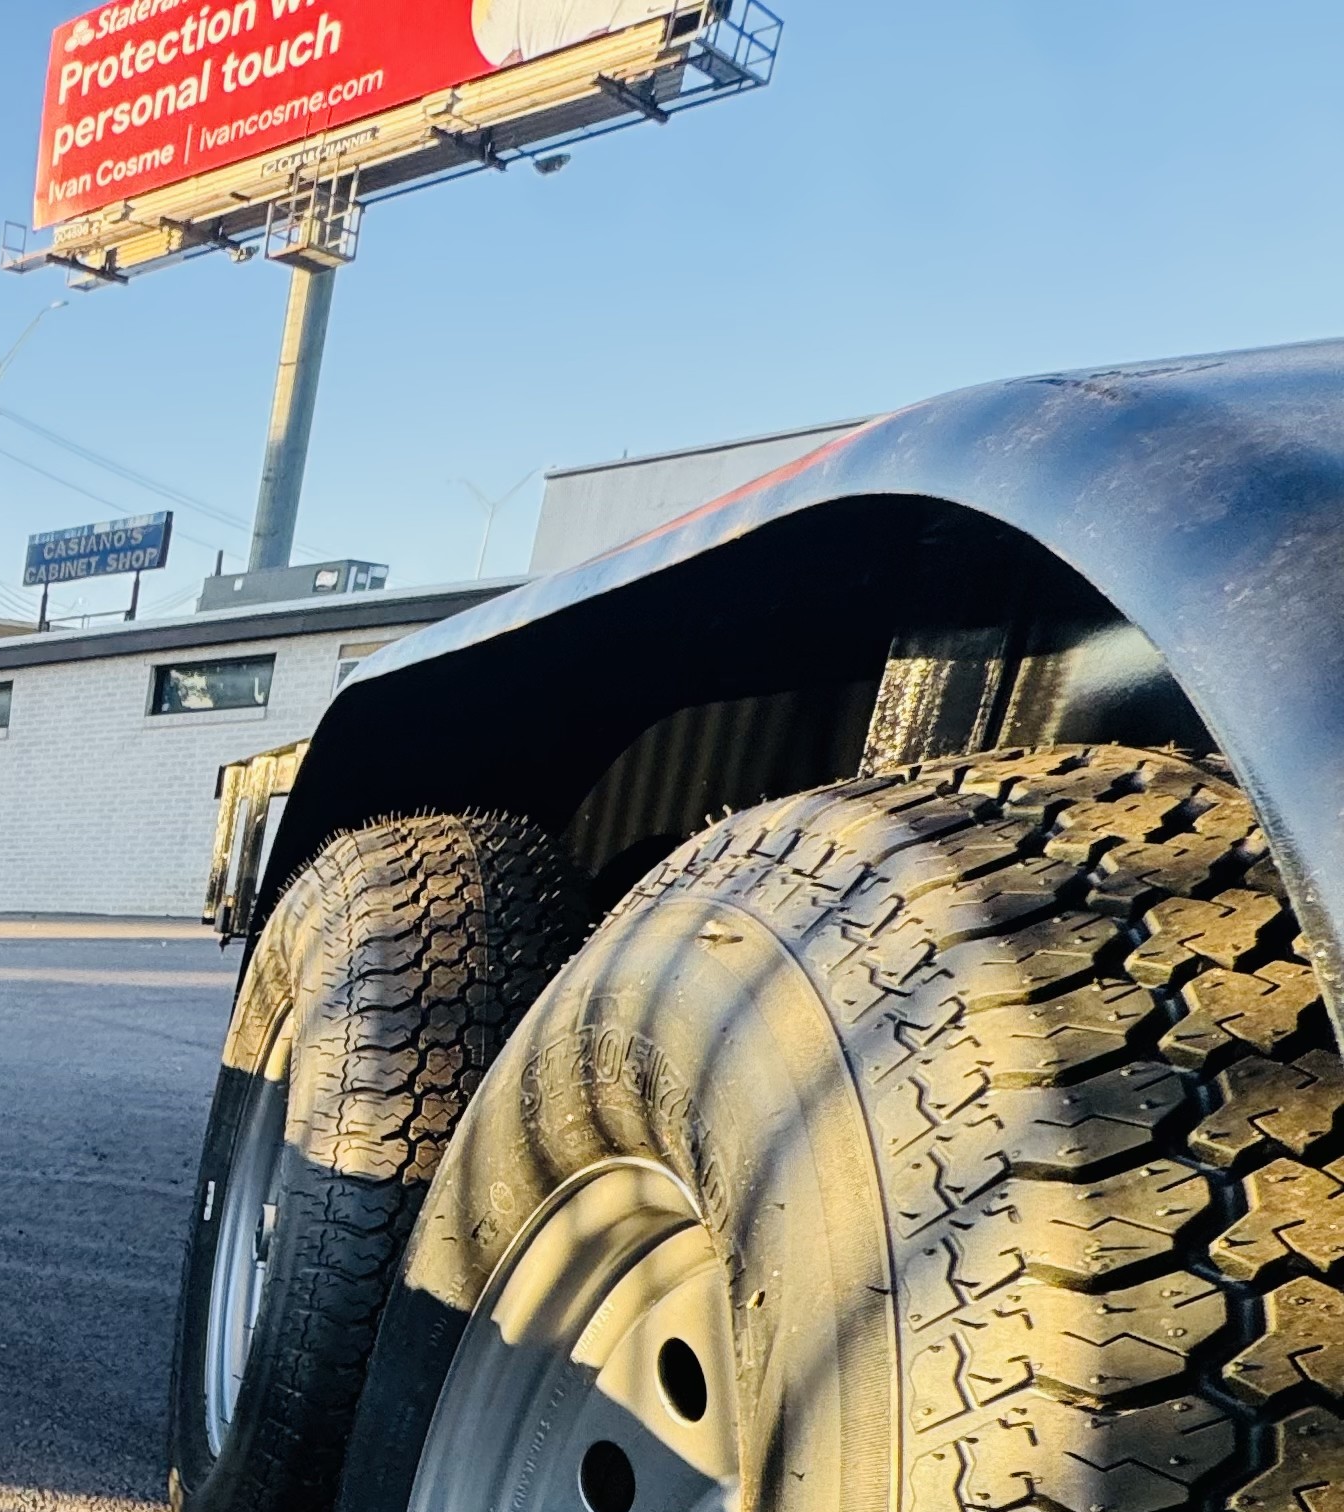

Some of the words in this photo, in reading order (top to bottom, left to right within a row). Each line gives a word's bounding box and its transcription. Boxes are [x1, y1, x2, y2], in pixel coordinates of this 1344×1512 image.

[58, 0, 256, 105] Protection
[52, 59, 212, 166] personal
[221, 13, 342, 93] touch
[317, 130, 373, 160] CHANNEL
[48, 171, 91, 205] Ivan
[96, 144, 175, 187] Cosme
[25, 556, 99, 583] CABINET
[107, 548, 160, 573] SHOP
[43, 528, 144, 560] CASIANO'S
